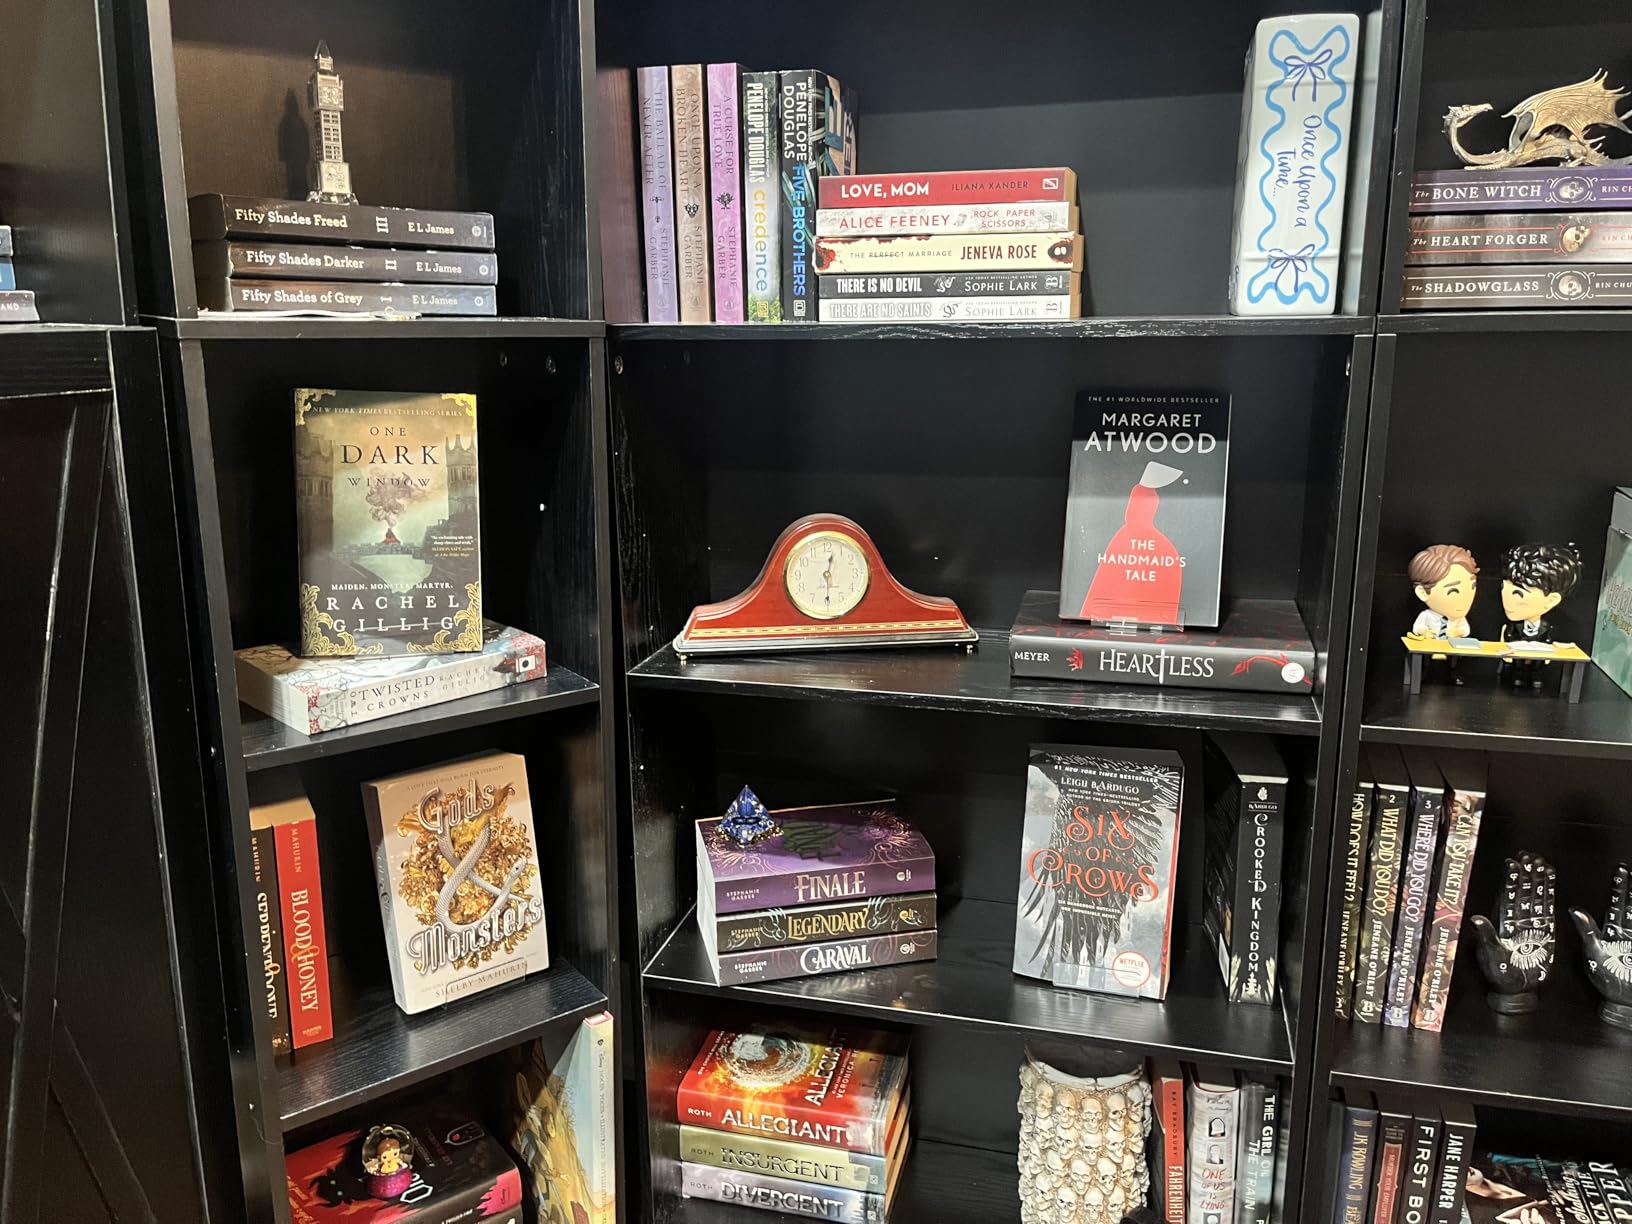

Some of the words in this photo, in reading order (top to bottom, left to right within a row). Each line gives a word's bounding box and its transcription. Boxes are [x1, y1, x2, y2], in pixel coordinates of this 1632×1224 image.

[655, 90, 664, 116] THE
[691, 93, 701, 133] ONCE
[723, 95, 732, 103] A
[746, 82, 764, 133] PENELOPE
[642, 97, 653, 141] NEVER
[676, 88, 688, 143] BROKEN
[712, 103, 722, 133] TRUE
[723, 107, 734, 146] CURSE
[783, 85, 796, 160] DOUGLAS
[796, 82, 808, 162] PENELOPE
[656, 119, 667, 169] BALLAD
[1302, 115, 1322, 161] Once
[643, 144, 654, 184] AFTER
[691, 138, 702, 176] UPON
[713, 138, 723, 168] LOVE
[726, 150, 735, 175] FOR
[748, 136, 766, 183] DOUGLAS
[657, 175, 667, 190] OF
[678, 150, 690, 194] HEART
[693, 180, 703, 190] A
[792, 165, 807, 203] FIVE
[840, 182, 888, 200] LOVE,
[890, 181, 930, 197] MOM
[951, 182, 986, 193] ILIANA
[988, 180, 1029, 191] XANDER
[1298, 165, 1317, 213] Upon
[1415, 190, 1430, 199] The
[1432, 185, 1479, 200] BONE
[1484, 184, 1542, 198] WITCH
[235, 209, 265, 224] Fifty
[267, 211, 312, 226] Shades
[314, 213, 348, 229] Freed
[839, 215, 884, 229] ALICE
[890, 213, 951, 227] FEENEY
[973, 209, 1000, 219] ROCK
[1006, 208, 1036, 218] PAPER
[981, 218, 1027, 229] SCISSORS
[1294, 216, 1307, 229] a
[408, 222, 416, 232] E
[417, 223, 424, 233] L
[424, 224, 455, 236] James
[753, 189, 768, 292] credence
[1413, 237, 1427, 245] The
[1431, 234, 1480, 247] HEART
[1484, 233, 1549, 246] FORGER
[246, 249, 276, 266] Fifty
[278, 251, 321, 267] Shades
[323, 255, 364, 270] Darker
[717, 235, 727, 280] GARBER
[727, 226, 738, 287] STEPHANIE
[792, 206, 807, 296] BROTHERS
[850, 251, 866, 259] THE
[868, 249, 905, 259] PERFECT
[908, 249, 953, 258] MARRIAGE
[960, 245, 1003, 261] JENEVA
[1008, 243, 1038, 259] ROSE
[416, 262, 424, 272] E
[424, 262, 432, 272] L
[432, 262, 462, 275] James
[242, 289, 272, 305] Fifty
[274, 289, 317, 304] Shades
[319, 290, 333, 304] of
[334, 291, 363, 306] Grey
[836, 278, 866, 294] THERE
[867, 278, 879, 293] IS
[880, 278, 895, 294] NO
[896, 277, 923, 293] DEVIL
[1425, 281, 1540, 294] SHADOWGLASS
[829, 302, 860, 318] THERE
[861, 302, 880, 318] ARE
[881, 302, 895, 318] NO
[897, 301, 931, 317] SAINTS
[369, 426, 408, 437] ONE
[1102, 412, 1202, 428] MARGARET
[340, 444, 439, 465] DARK
[1084, 430, 1217, 454] ATWOOD
[347, 476, 431, 488] WINDOW
[1130, 538, 1155, 551] THE
[1097, 553, 1187, 568] HANDMAID'S
[331, 583, 368, 591] MAIDEN.
[370, 582, 415, 591] MONSTER.
[416, 582, 453, 590] MARTYR.
[1124, 569, 1157, 582] TALE
[326, 594, 460, 611] RACHEL
[333, 616, 454, 632] GILLIG
[1014, 650, 1050, 663] MEYER
[1100, 648, 1214, 684] HEARTLESS
[358, 675, 435, 701] TWISTED
[367, 691, 430, 713] CROWNS
[1061, 777, 1088, 788] LEIGH
[1091, 780, 1140, 795] BARDUGO
[418, 777, 496, 835] Gods
[1066, 805, 1136, 851] SIX
[1381, 808, 1399, 837] WHAT
[1412, 814, 1434, 851] WHERE
[1456, 814, 1473, 837] CAN
[291, 828, 302, 874] MAHURIN
[1086, 846, 1112, 864] OF
[1248, 812, 1269, 894] CROOKED
[1378, 836, 1397, 861] DID
[1411, 851, 1429, 872] DID
[1450, 838, 1469, 862] YOU
[794, 871, 867, 903] FINALE
[1027, 848, 1159, 903] CROWS
[1374, 863, 1392, 889] YOU
[1408, 873, 1426, 897] YOU
[1445, 861, 1465, 889] TAKE
[1371, 889, 1390, 917] DO?
[1405, 897, 1423, 923] GO?
[1442, 888, 1461, 906] IT?
[290, 889, 312, 950] BLOOD
[787, 907, 871, 942] LEGENDARY
[406, 897, 544, 976] Monsters
[1247, 897, 1263, 972] KINGDOM
[1369, 919, 1383, 960] JENEANE
[1401, 926, 1415, 967] JENEANE
[800, 944, 872, 976] CARAVAL
[1119, 957, 1145, 968] NETFLIX
[297, 952, 319, 1012] HONEY
[435, 978, 475, 999] SHELBY
[478, 961, 528, 985] MAHURIN
[1365, 961, 1378, 997] O'RILEY
[1396, 967, 1409, 1004] O'RILEY
[836, 1060, 856, 1100] VERONICA
[688, 1107, 712, 1118] ROTH
[1263, 1095, 1276, 1122] THE
[721, 1108, 846, 1144] ALLEGIANT
[1171, 1111, 1179, 1157] BRADBURY
[691, 1147, 714, 1157] ROTH
[1249, 1139, 1261, 1167] THE
[1260, 1125, 1274, 1157] GIRL
[1445, 1133, 1464, 1162] JANE
[720, 1147, 845, 1183] INSURGENT
[1348, 1146, 1368, 1191] ROWLING
[1412, 1125, 1435, 1189] FIRST
[690, 1181, 713, 1190] ROTH
[1201, 1168, 1227, 1180] ONE
[1438, 1165, 1460, 1209] HARPER
[720, 1181, 844, 1219] DIVERGENT
[1168, 1165, 1184, 1224] FAHRENHEIT
[1244, 1167, 1260, 1211] TRAIN
[1200, 1200, 1226, 1211] LYING
